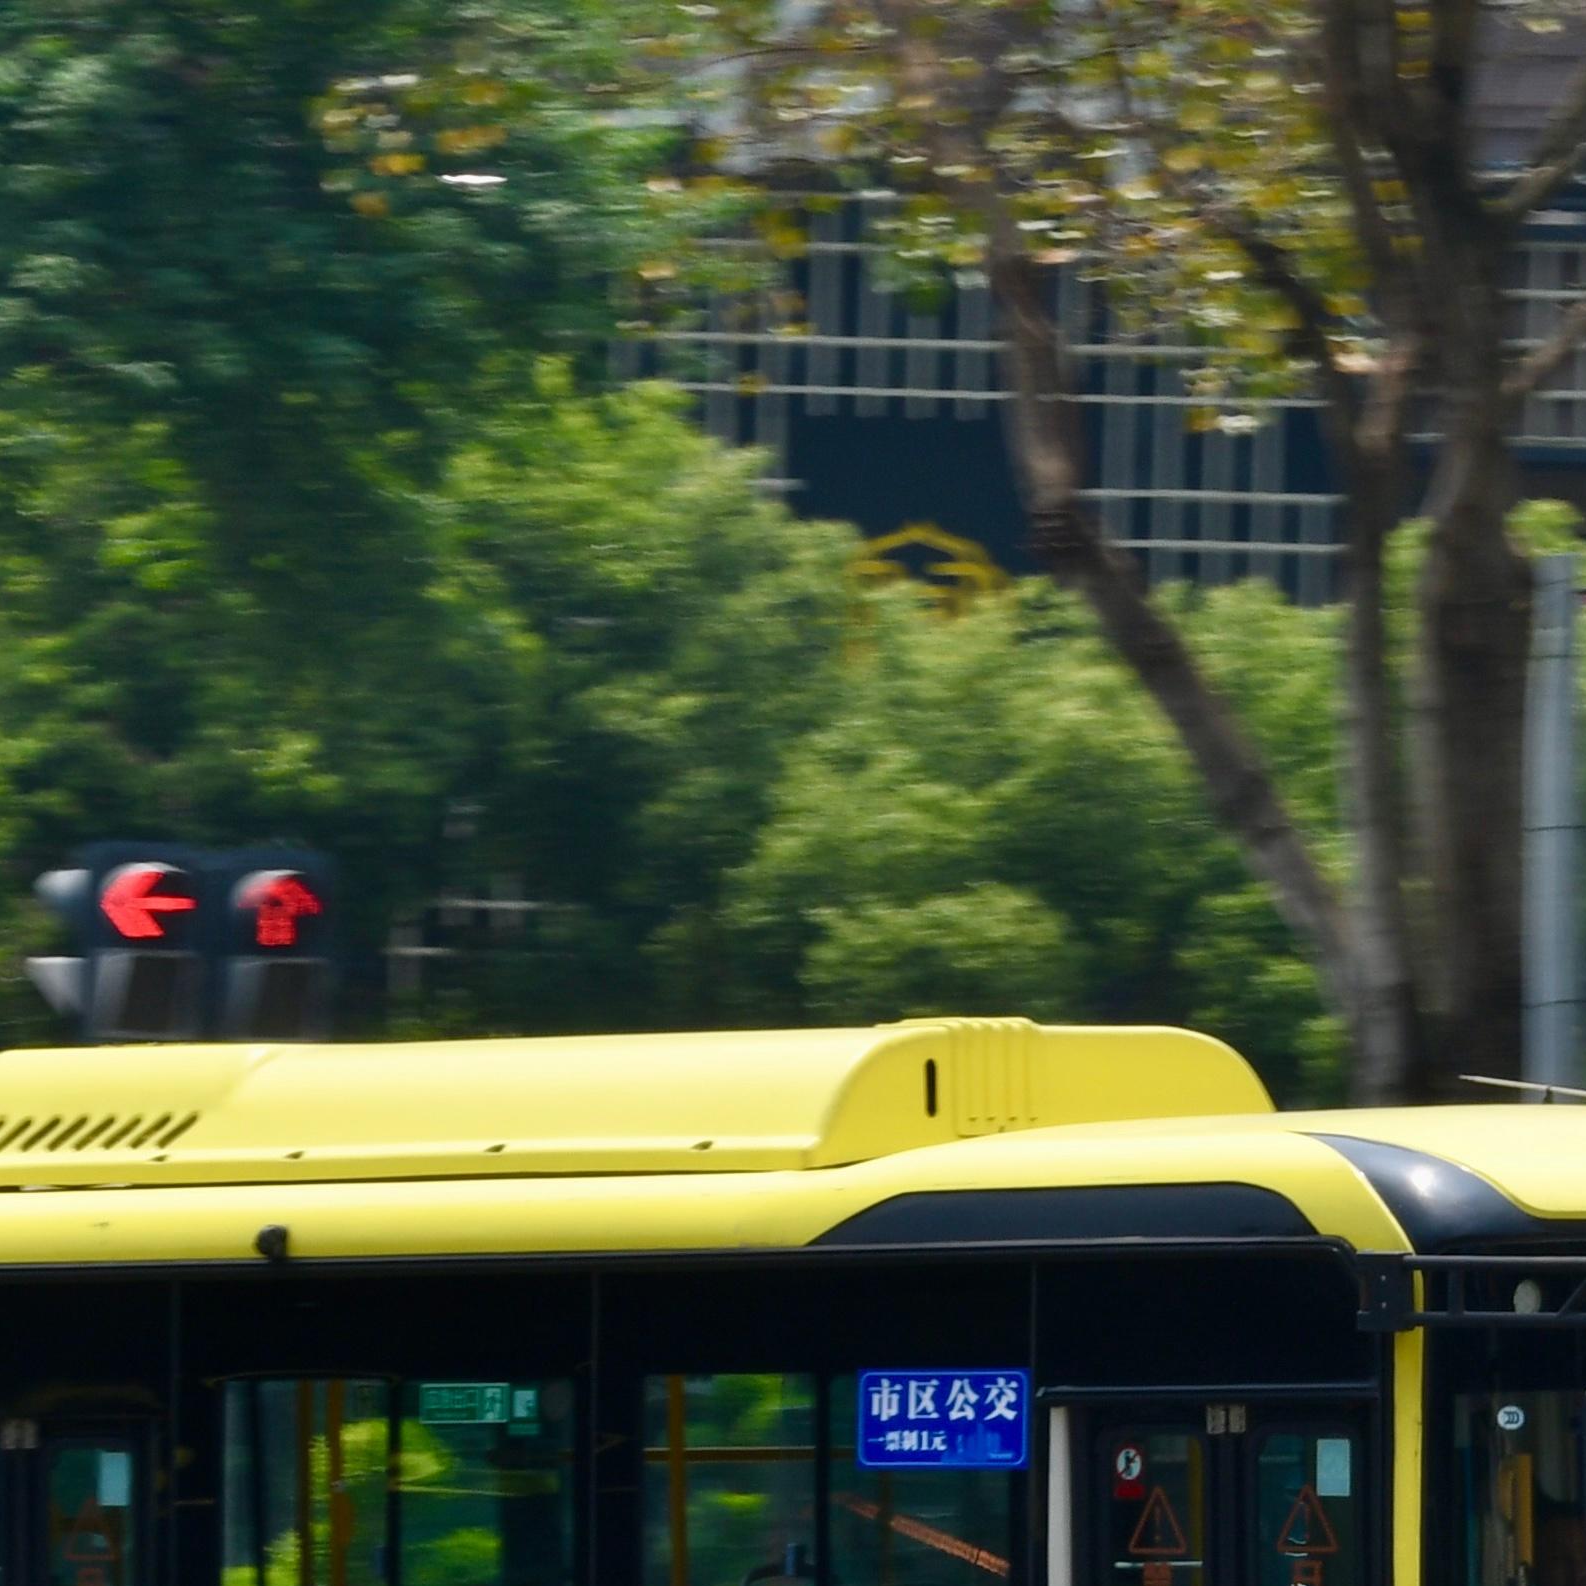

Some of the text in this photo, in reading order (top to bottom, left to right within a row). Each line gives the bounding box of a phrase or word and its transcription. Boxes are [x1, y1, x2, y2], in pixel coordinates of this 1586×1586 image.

[867, 1377, 1019, 1422] 市区公交
[867, 1429, 949, 1452] 一票制1元
